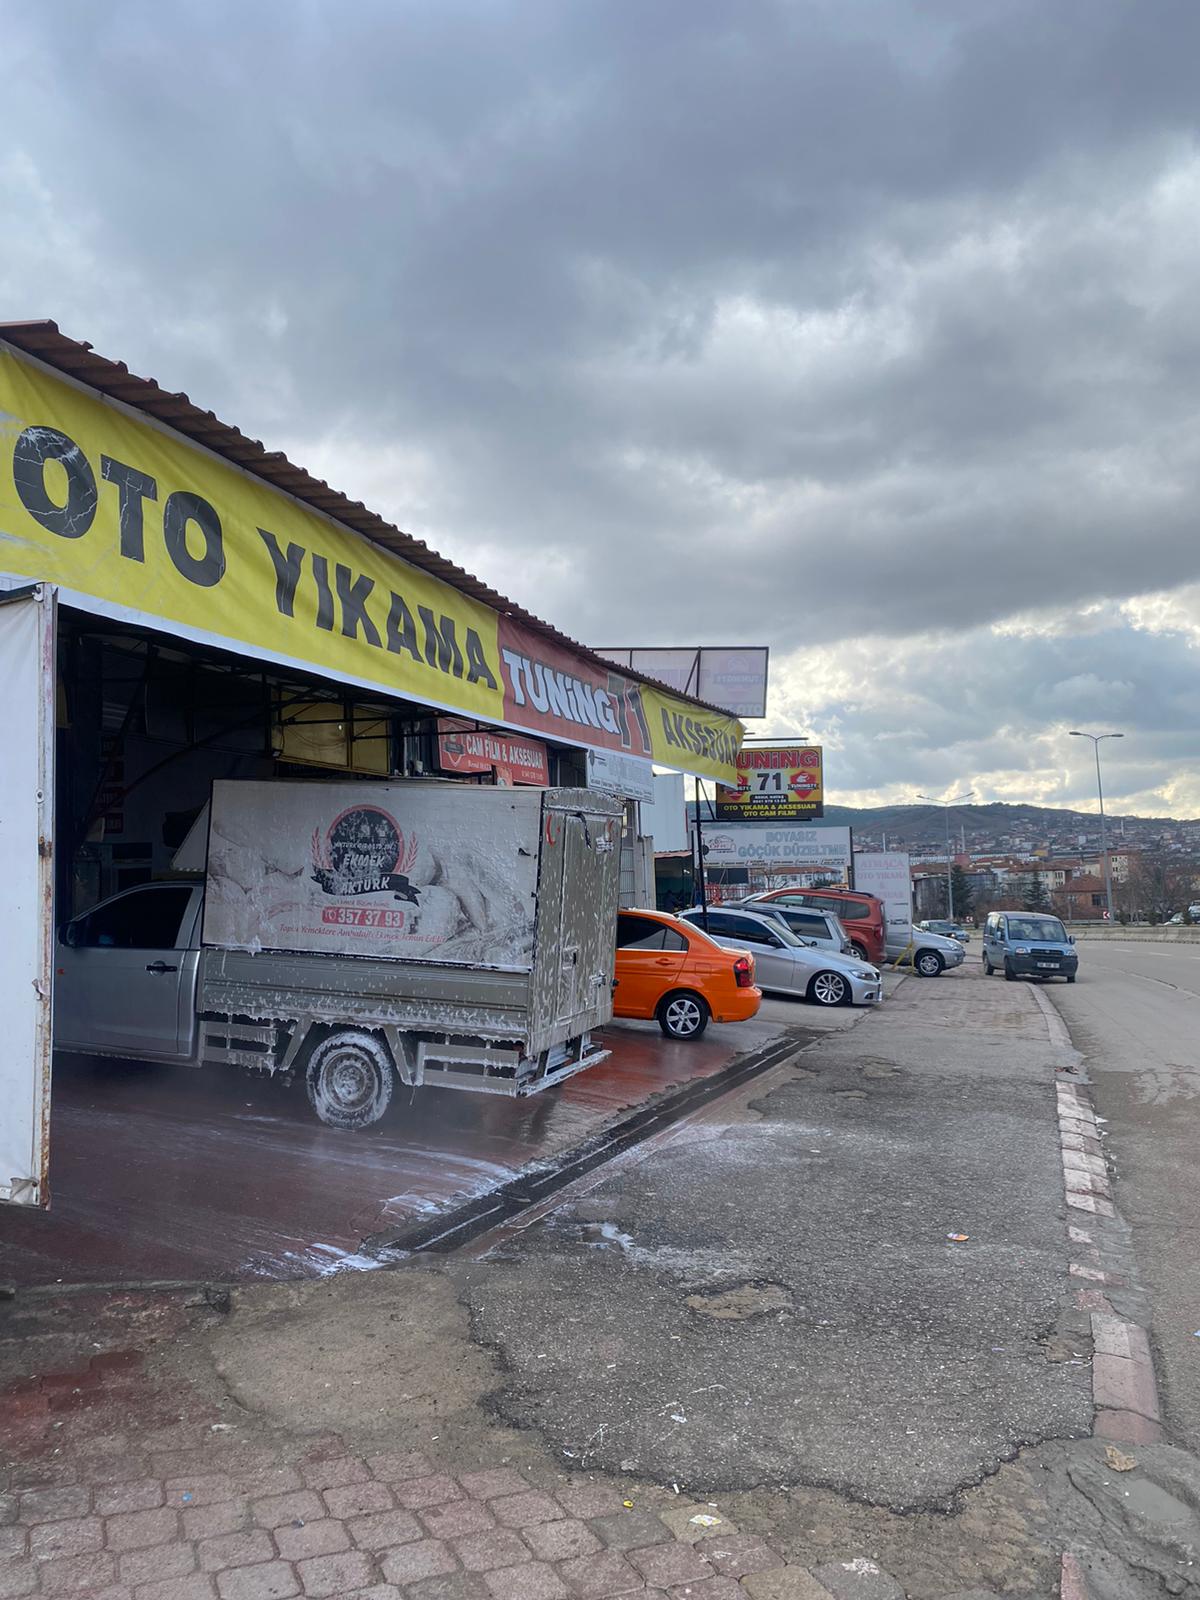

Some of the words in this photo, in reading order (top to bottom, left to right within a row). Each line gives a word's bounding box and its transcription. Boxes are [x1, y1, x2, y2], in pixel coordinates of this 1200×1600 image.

[13, 425, 227, 588] OTO
[256, 527, 499, 691] YIKAMA
[466, 734, 484, 758] CAM
[502, 743, 508, 763] &
[509, 744, 544, 769] AKSESUAR
[757, 772, 782, 790] 71
[765, 831, 817, 842] BOYASIZ
[783, 843, 847, 856] DÜZELTME
[343, 853, 385, 868] EKMEK
[338, 908, 362, 924] 357
[365, 910, 381, 925] 37
[385, 911, 401, 927] 93
